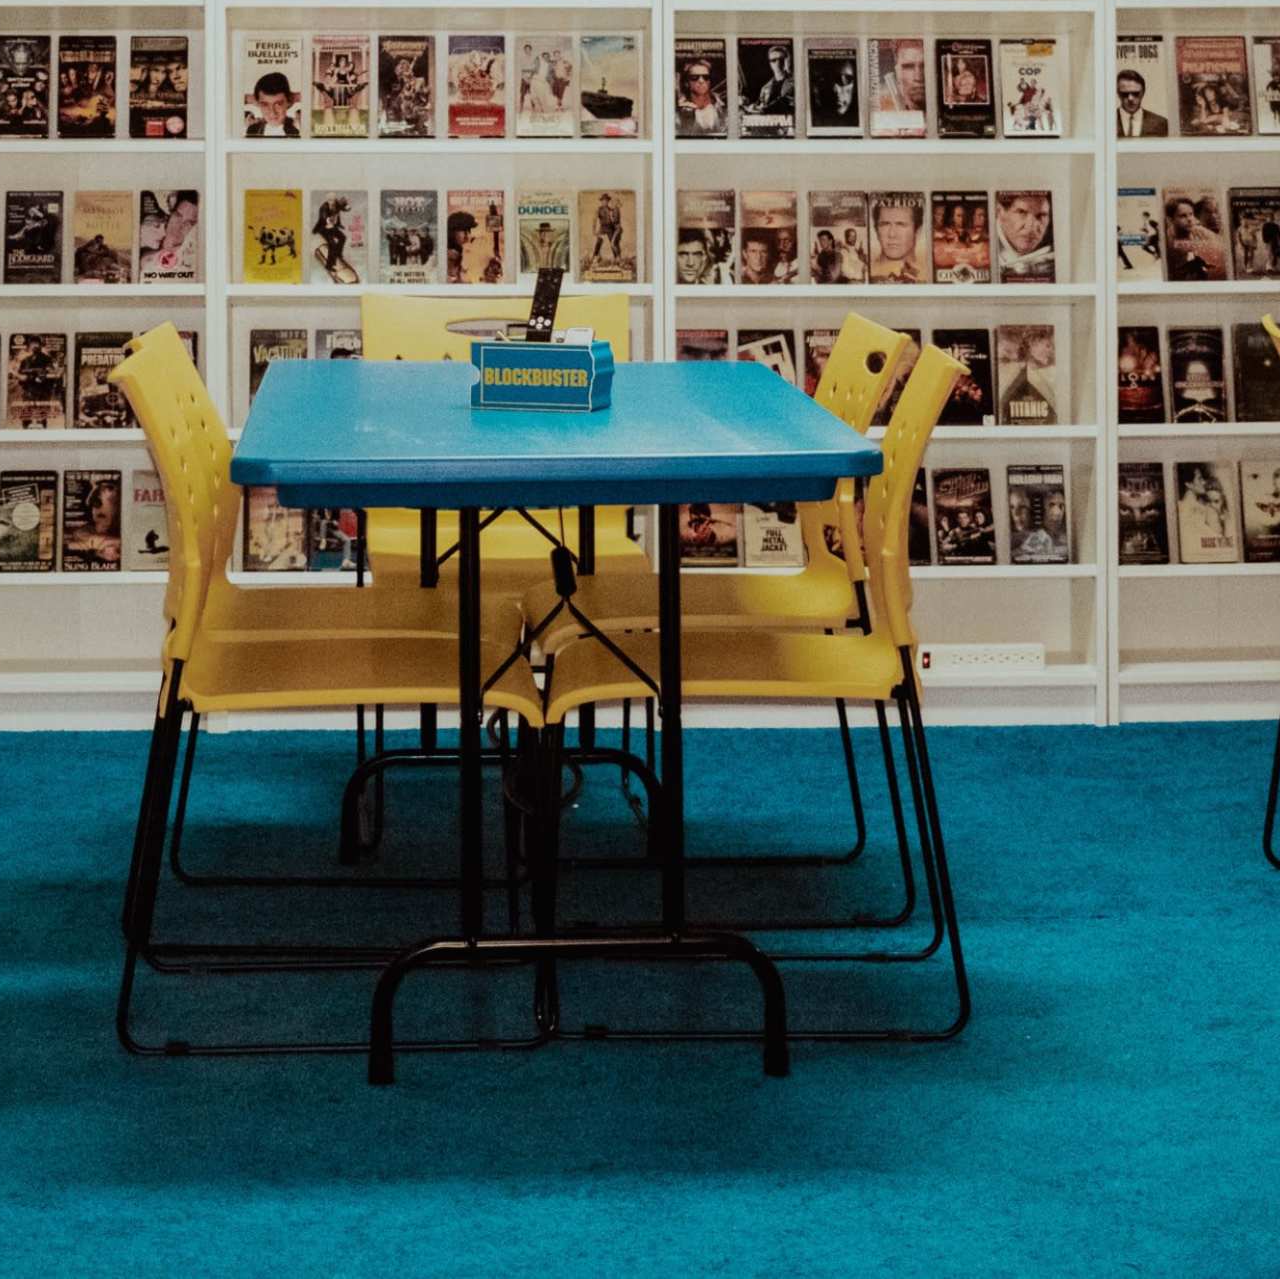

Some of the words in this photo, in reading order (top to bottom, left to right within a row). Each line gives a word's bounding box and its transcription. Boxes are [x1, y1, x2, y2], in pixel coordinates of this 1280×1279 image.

[248, 50, 299, 58] BUELLER'S
[1138, 45, 1158, 58] DOGS
[1019, 67, 1042, 76] COP
[871, 199, 924, 209] PATRIOT
[518, 206, 569, 215] DUNDEE
[8, 253, 55, 265] BODYGUARD
[158, 271, 176, 279] WAY
[253, 345, 303, 363] VACATION
[485, 368, 588, 388] BLOCKBUSTER
[1009, 400, 1049, 418] TITANIC
[134, 488, 165, 503] FAR
[763, 536, 785, 544] METAL
[760, 544, 788, 552] JACKET
[91, 562, 118, 570] BLADE
